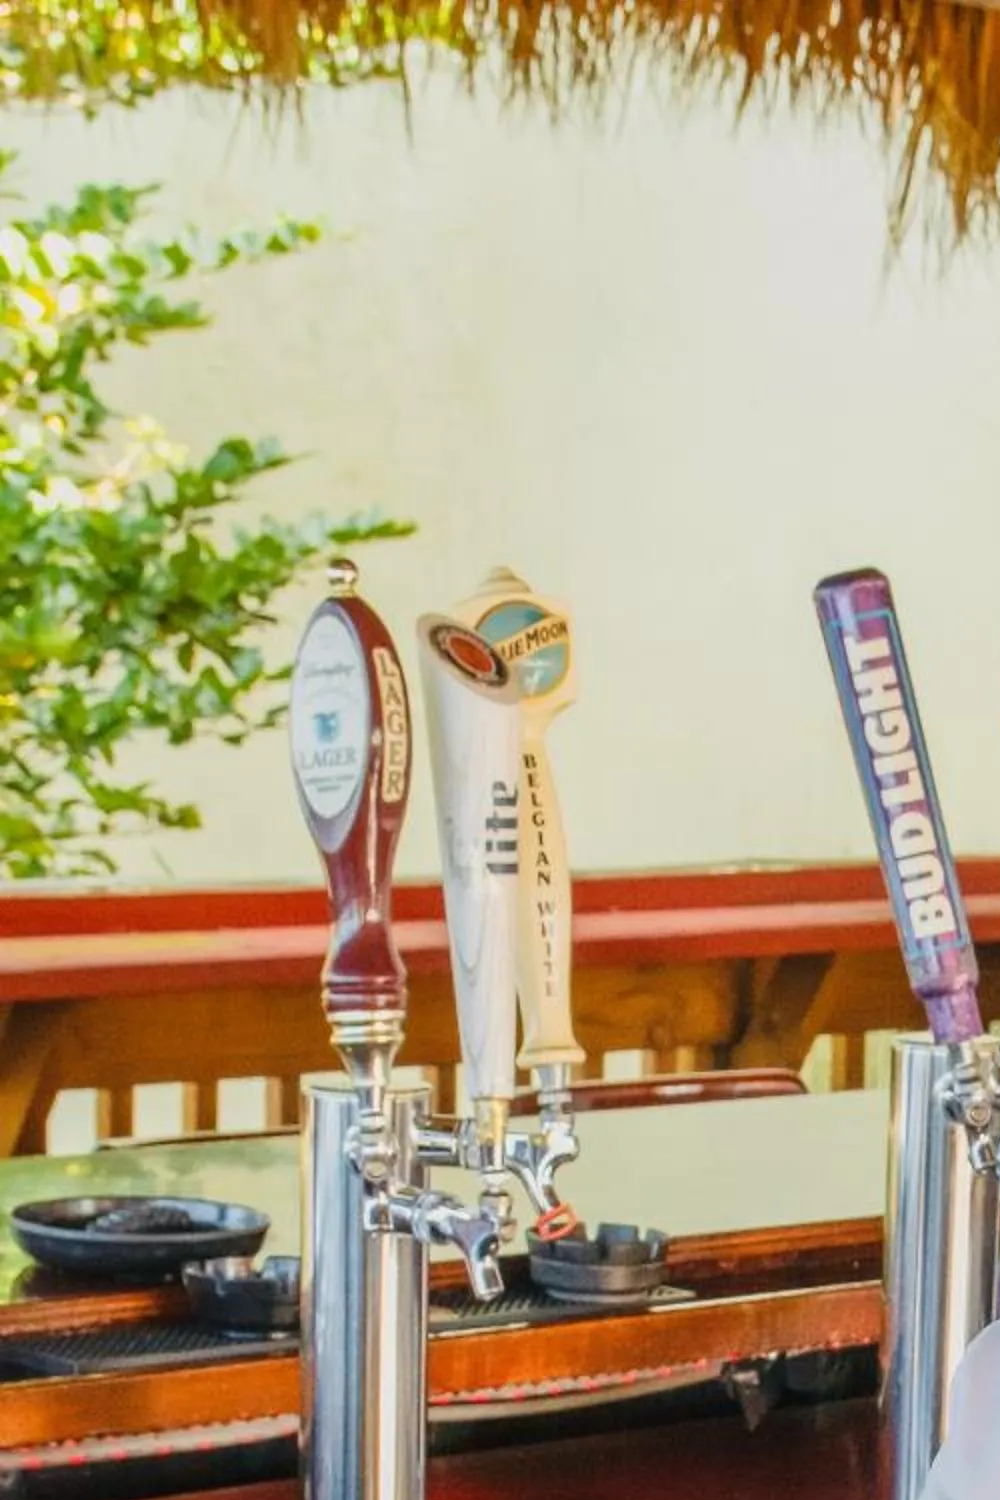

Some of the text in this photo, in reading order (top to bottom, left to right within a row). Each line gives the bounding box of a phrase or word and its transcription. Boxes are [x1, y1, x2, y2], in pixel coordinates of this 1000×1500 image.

[525, 620, 569, 651] MOON
[300, 746, 357, 770] LAGER
[377, 652, 405, 796] LAGER
[484, 780, 519, 875] lite
[523, 754, 552, 887] BELGIAN
[843, 634, 957, 940] BUD LIGHT
